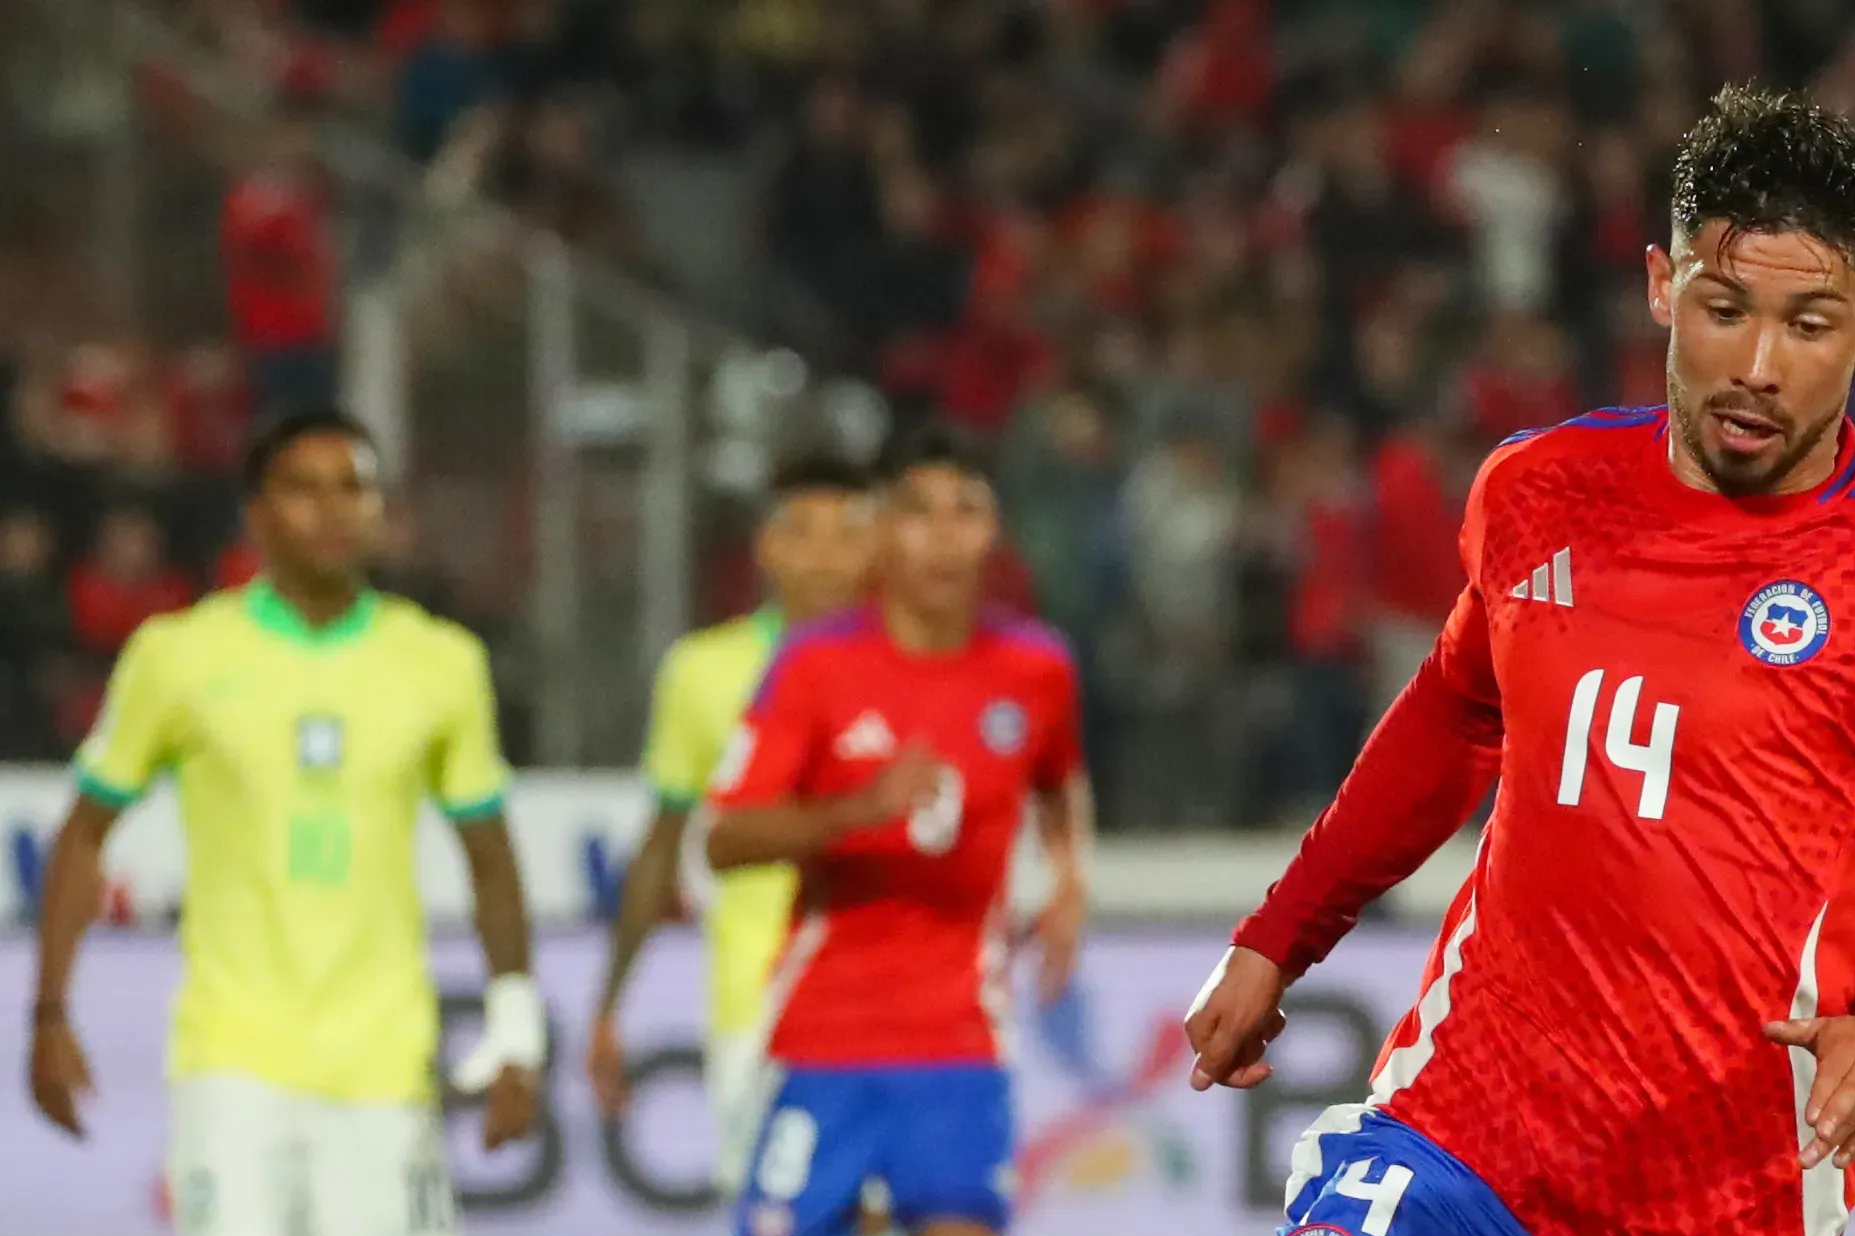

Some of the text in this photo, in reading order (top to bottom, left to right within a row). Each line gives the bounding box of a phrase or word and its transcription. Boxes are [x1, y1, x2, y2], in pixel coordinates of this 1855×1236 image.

[1744, 584, 1795, 617] FEDERACION
[1800, 588, 1813, 602] DE
[1751, 645, 1796, 664] DE CHILE
[1557, 668, 1681, 820] 14
[289, 808, 352, 886] 10
